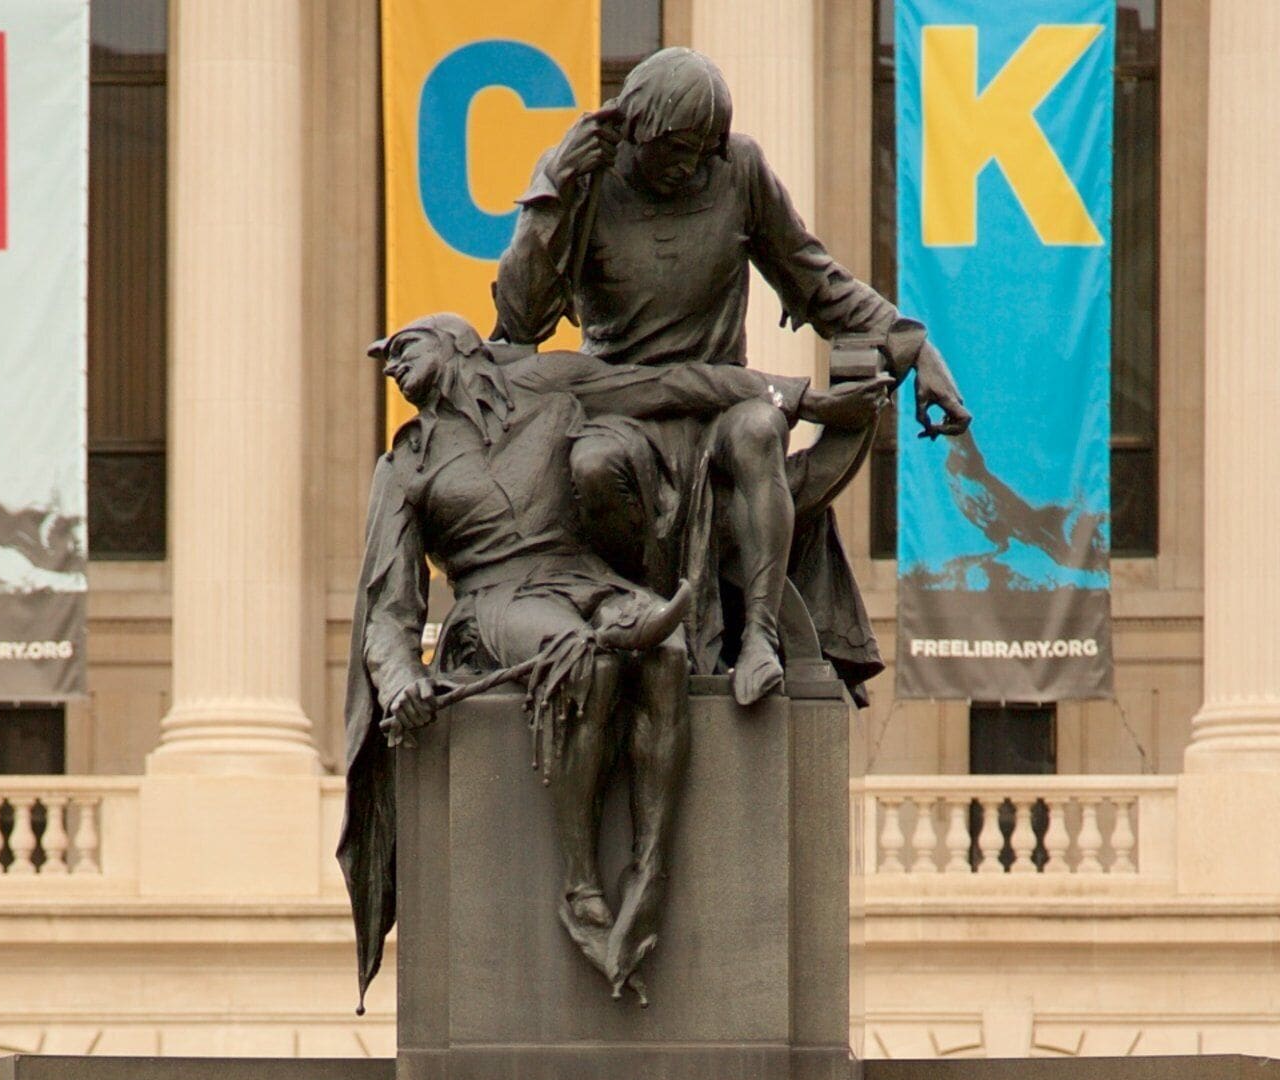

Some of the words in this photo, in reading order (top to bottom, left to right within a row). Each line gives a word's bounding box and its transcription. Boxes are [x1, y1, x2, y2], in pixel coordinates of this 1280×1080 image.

[417, 39, 577, 261] C
[922, 24, 1107, 247] K
[910, 638, 1099, 658] FREELIBRARY.ORG
